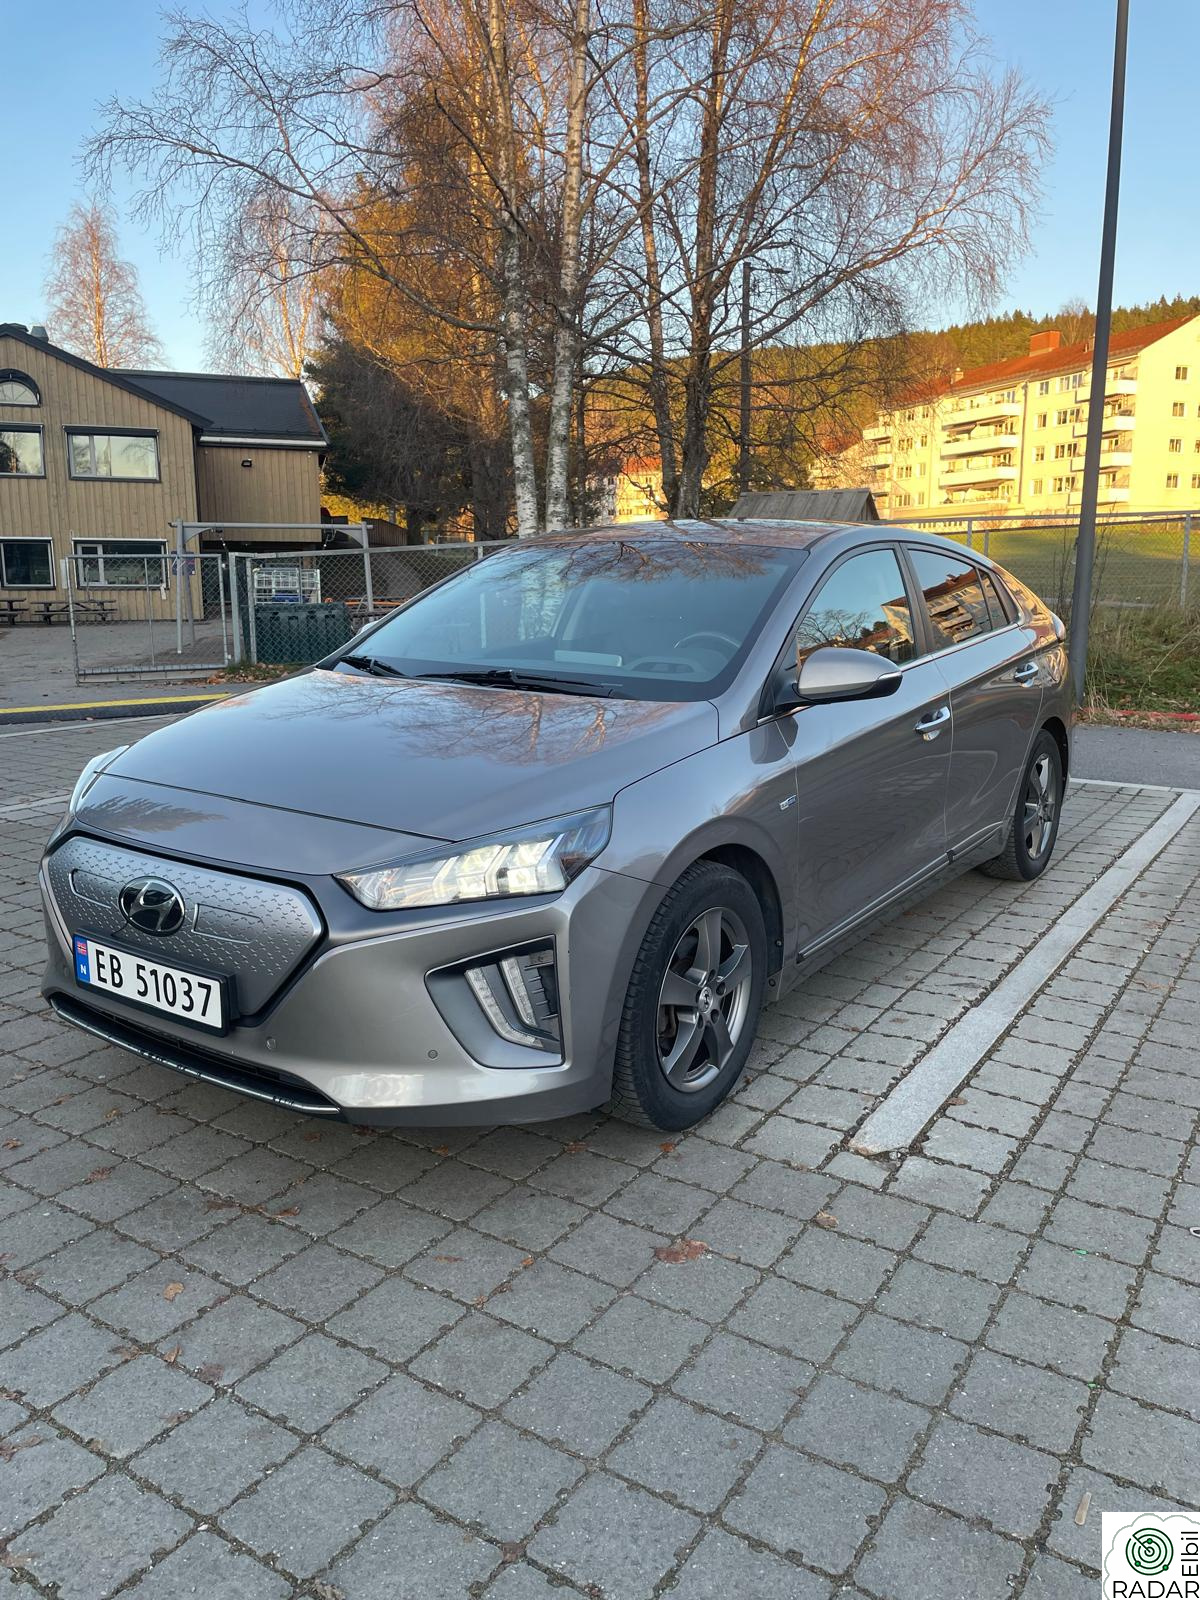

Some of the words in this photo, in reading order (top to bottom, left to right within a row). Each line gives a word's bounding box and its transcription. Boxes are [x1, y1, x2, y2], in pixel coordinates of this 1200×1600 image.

[80, 964, 87, 975] N
[95, 949, 123, 988] EB
[136, 963, 212, 1017] 51037
